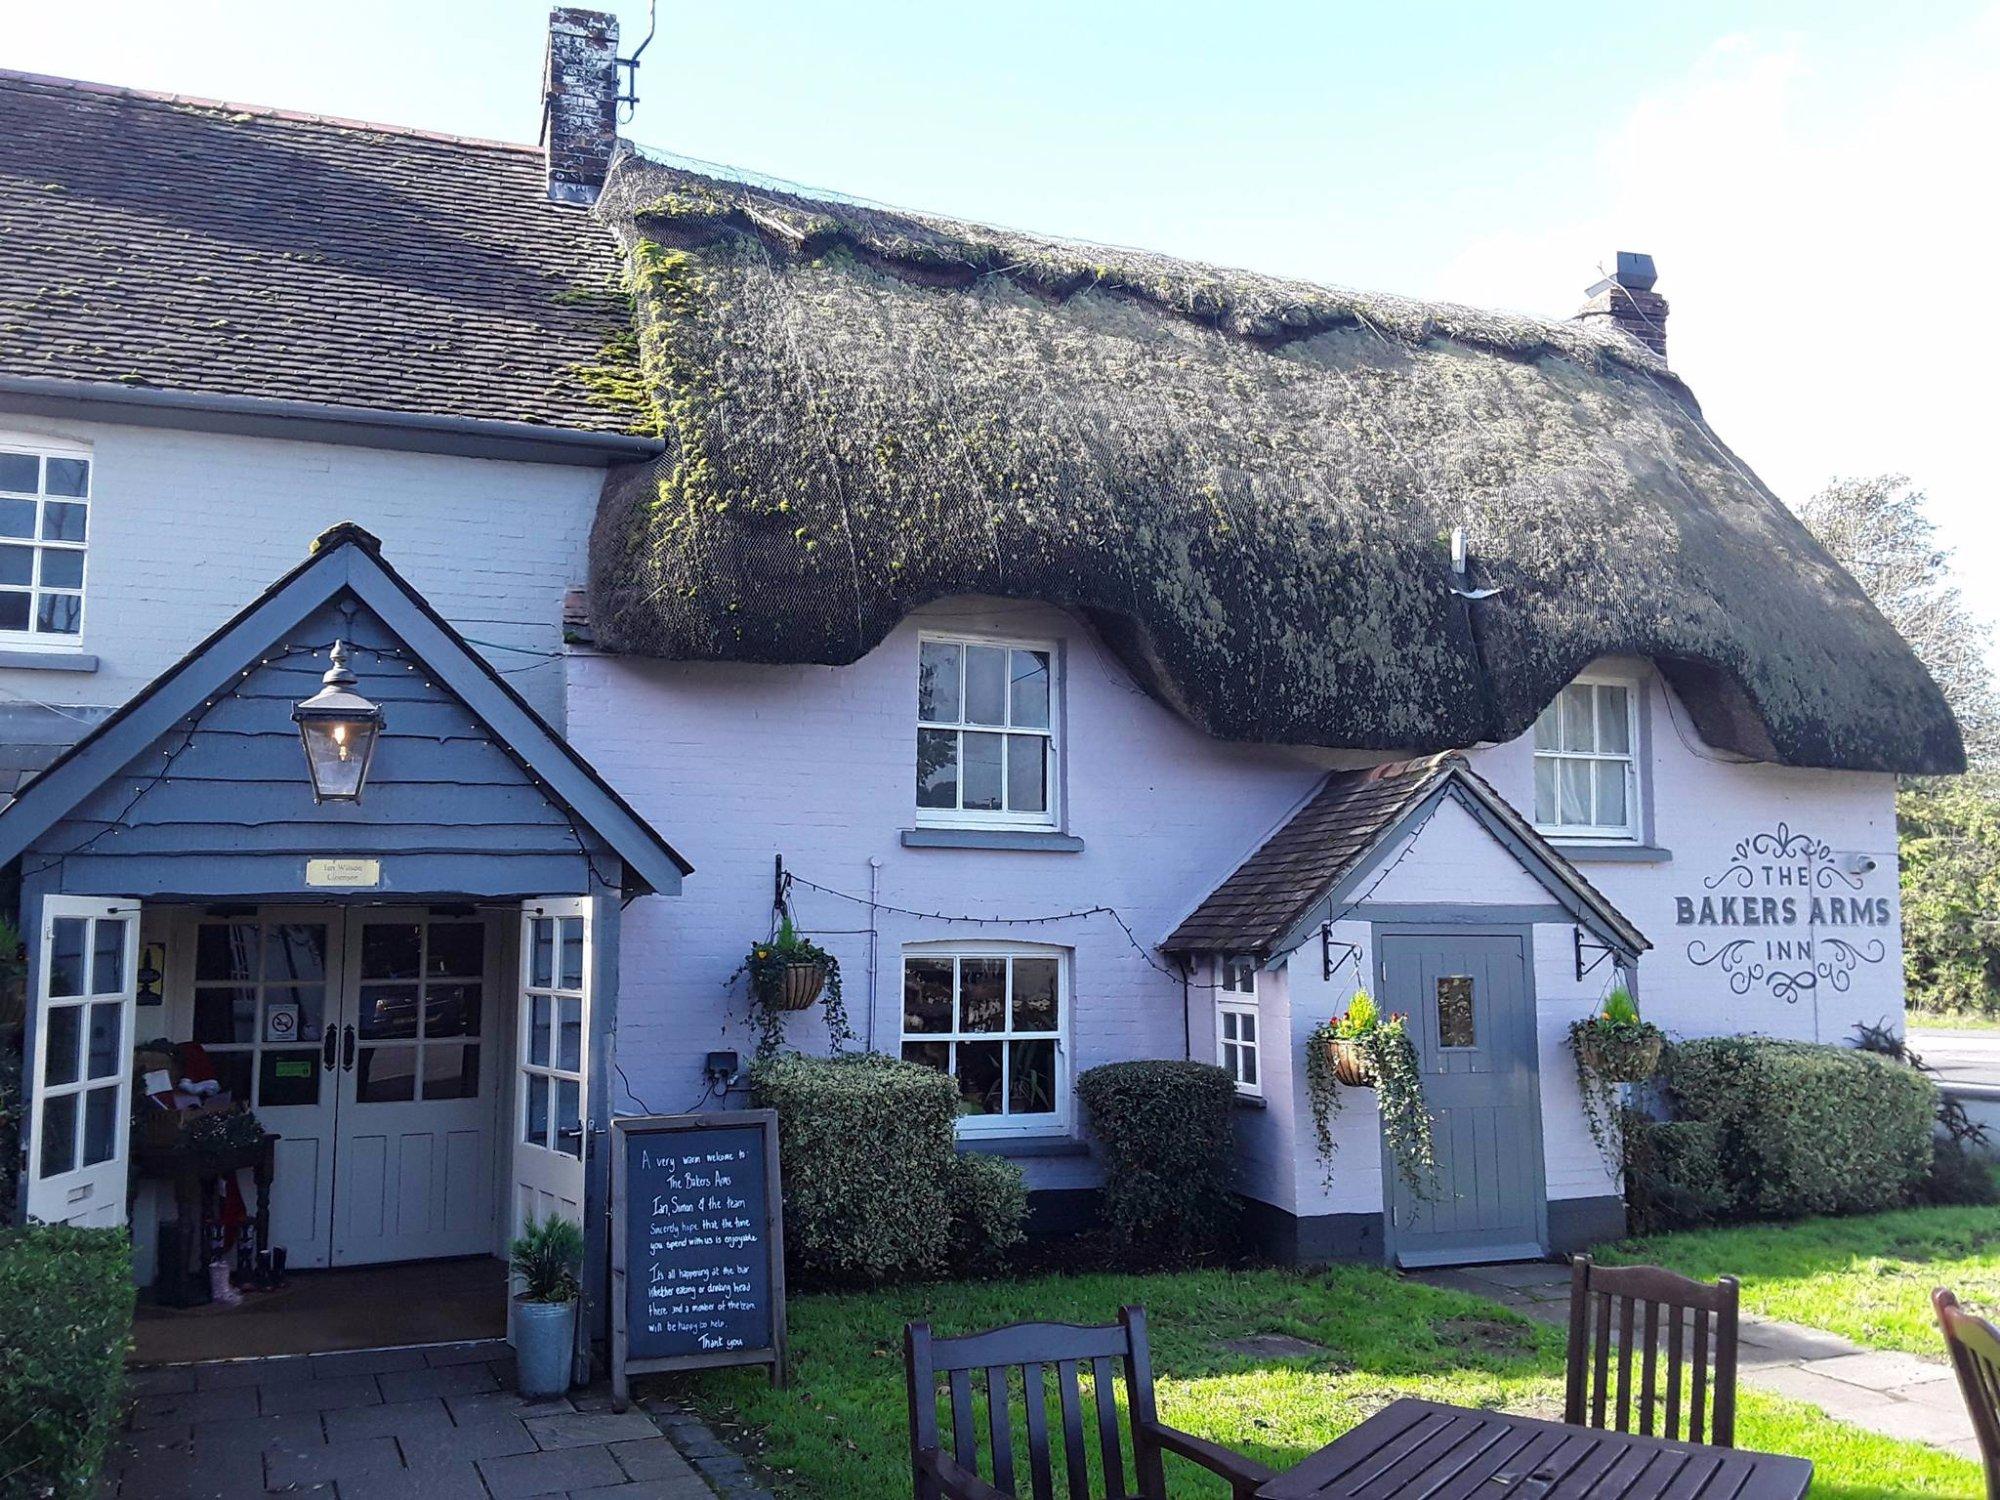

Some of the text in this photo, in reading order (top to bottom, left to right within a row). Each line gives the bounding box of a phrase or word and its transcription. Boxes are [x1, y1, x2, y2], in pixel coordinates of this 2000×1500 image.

[1762, 866, 1810, 886] THE
[1674, 896, 1892, 928] BAKERS ARMS
[1766, 941, 1812, 961] INN
[642, 1150, 651, 1170] A
[656, 1156, 676, 1172] very
[682, 1156, 700, 1164] warm
[706, 1150, 734, 1162] welcome
[666, 1170, 732, 1190] The Bakers Arms
[652, 1195, 746, 1217] Ian, Simon & the team
[682, 1221, 699, 1232] hope
[702, 1218, 718, 1230] that
[722, 1218, 734, 1229] the
[734, 1216, 751, 1228] time
[650, 1242, 663, 1256] you
[666, 1238, 687, 1250] spend
[688, 1236, 704, 1246] with
[724, 1233, 758, 1248] enjoyable
[668, 1268, 676, 1279] all
[678, 1268, 710, 1282] happening
[712, 1266, 720, 1276] at
[722, 1266, 734, 1276] the
[736, 1264, 750, 1274] bar
[676, 1286, 696, 1300] eating
[698, 1286, 706, 1294] or
[707, 1282, 732, 1299] drinking
[732, 1282, 751, 1293] head
[648, 1302, 668, 1317] there
[672, 1304, 683, 1314] and
[692, 1302, 715, 1312] member
[718, 1300, 726, 1310] of
[728, 1300, 740, 1310] the
[740, 1300, 756, 1310] team
[648, 1322, 662, 1333] will
[666, 1320, 676, 1332] be
[678, 1320, 698, 1334] happy
[698, 1332, 744, 1350] Thank you
